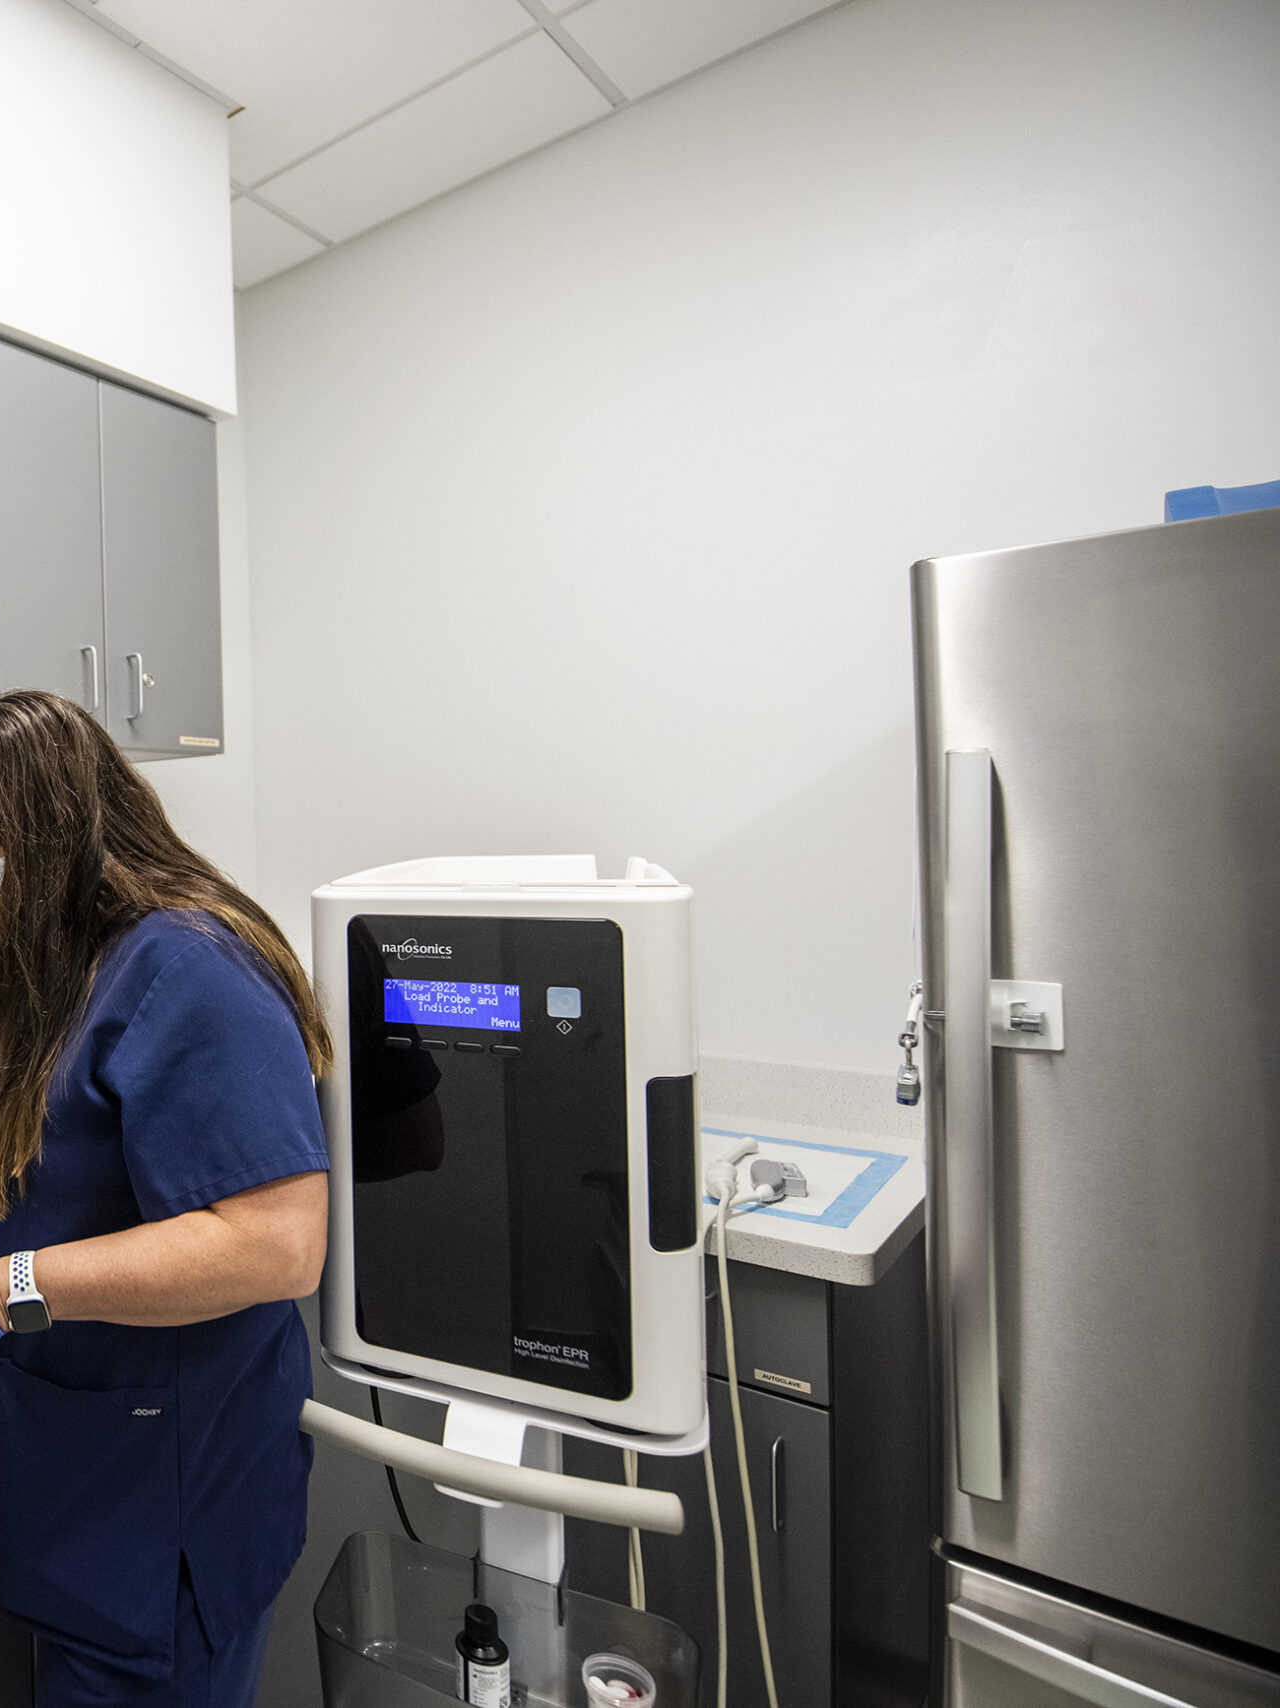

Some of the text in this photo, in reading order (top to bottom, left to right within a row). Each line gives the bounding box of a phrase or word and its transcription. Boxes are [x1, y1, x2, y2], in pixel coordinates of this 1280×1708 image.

[382, 943, 453, 956] nanosonics
[385, 980, 520, 997] 27-May-2022 8:51 AM
[404, 991, 499, 1006] Load Probe and
[418, 1002, 478, 1015] Indicator
[490, 1017, 520, 1029] Menu
[514, 1347, 590, 1369] High Level Disinfection
[562, 1346, 590, 1362] EPR
[762, 1374, 801, 1388] AUTOCLAVE
[131, 1408, 162, 1416] JOCKEY
